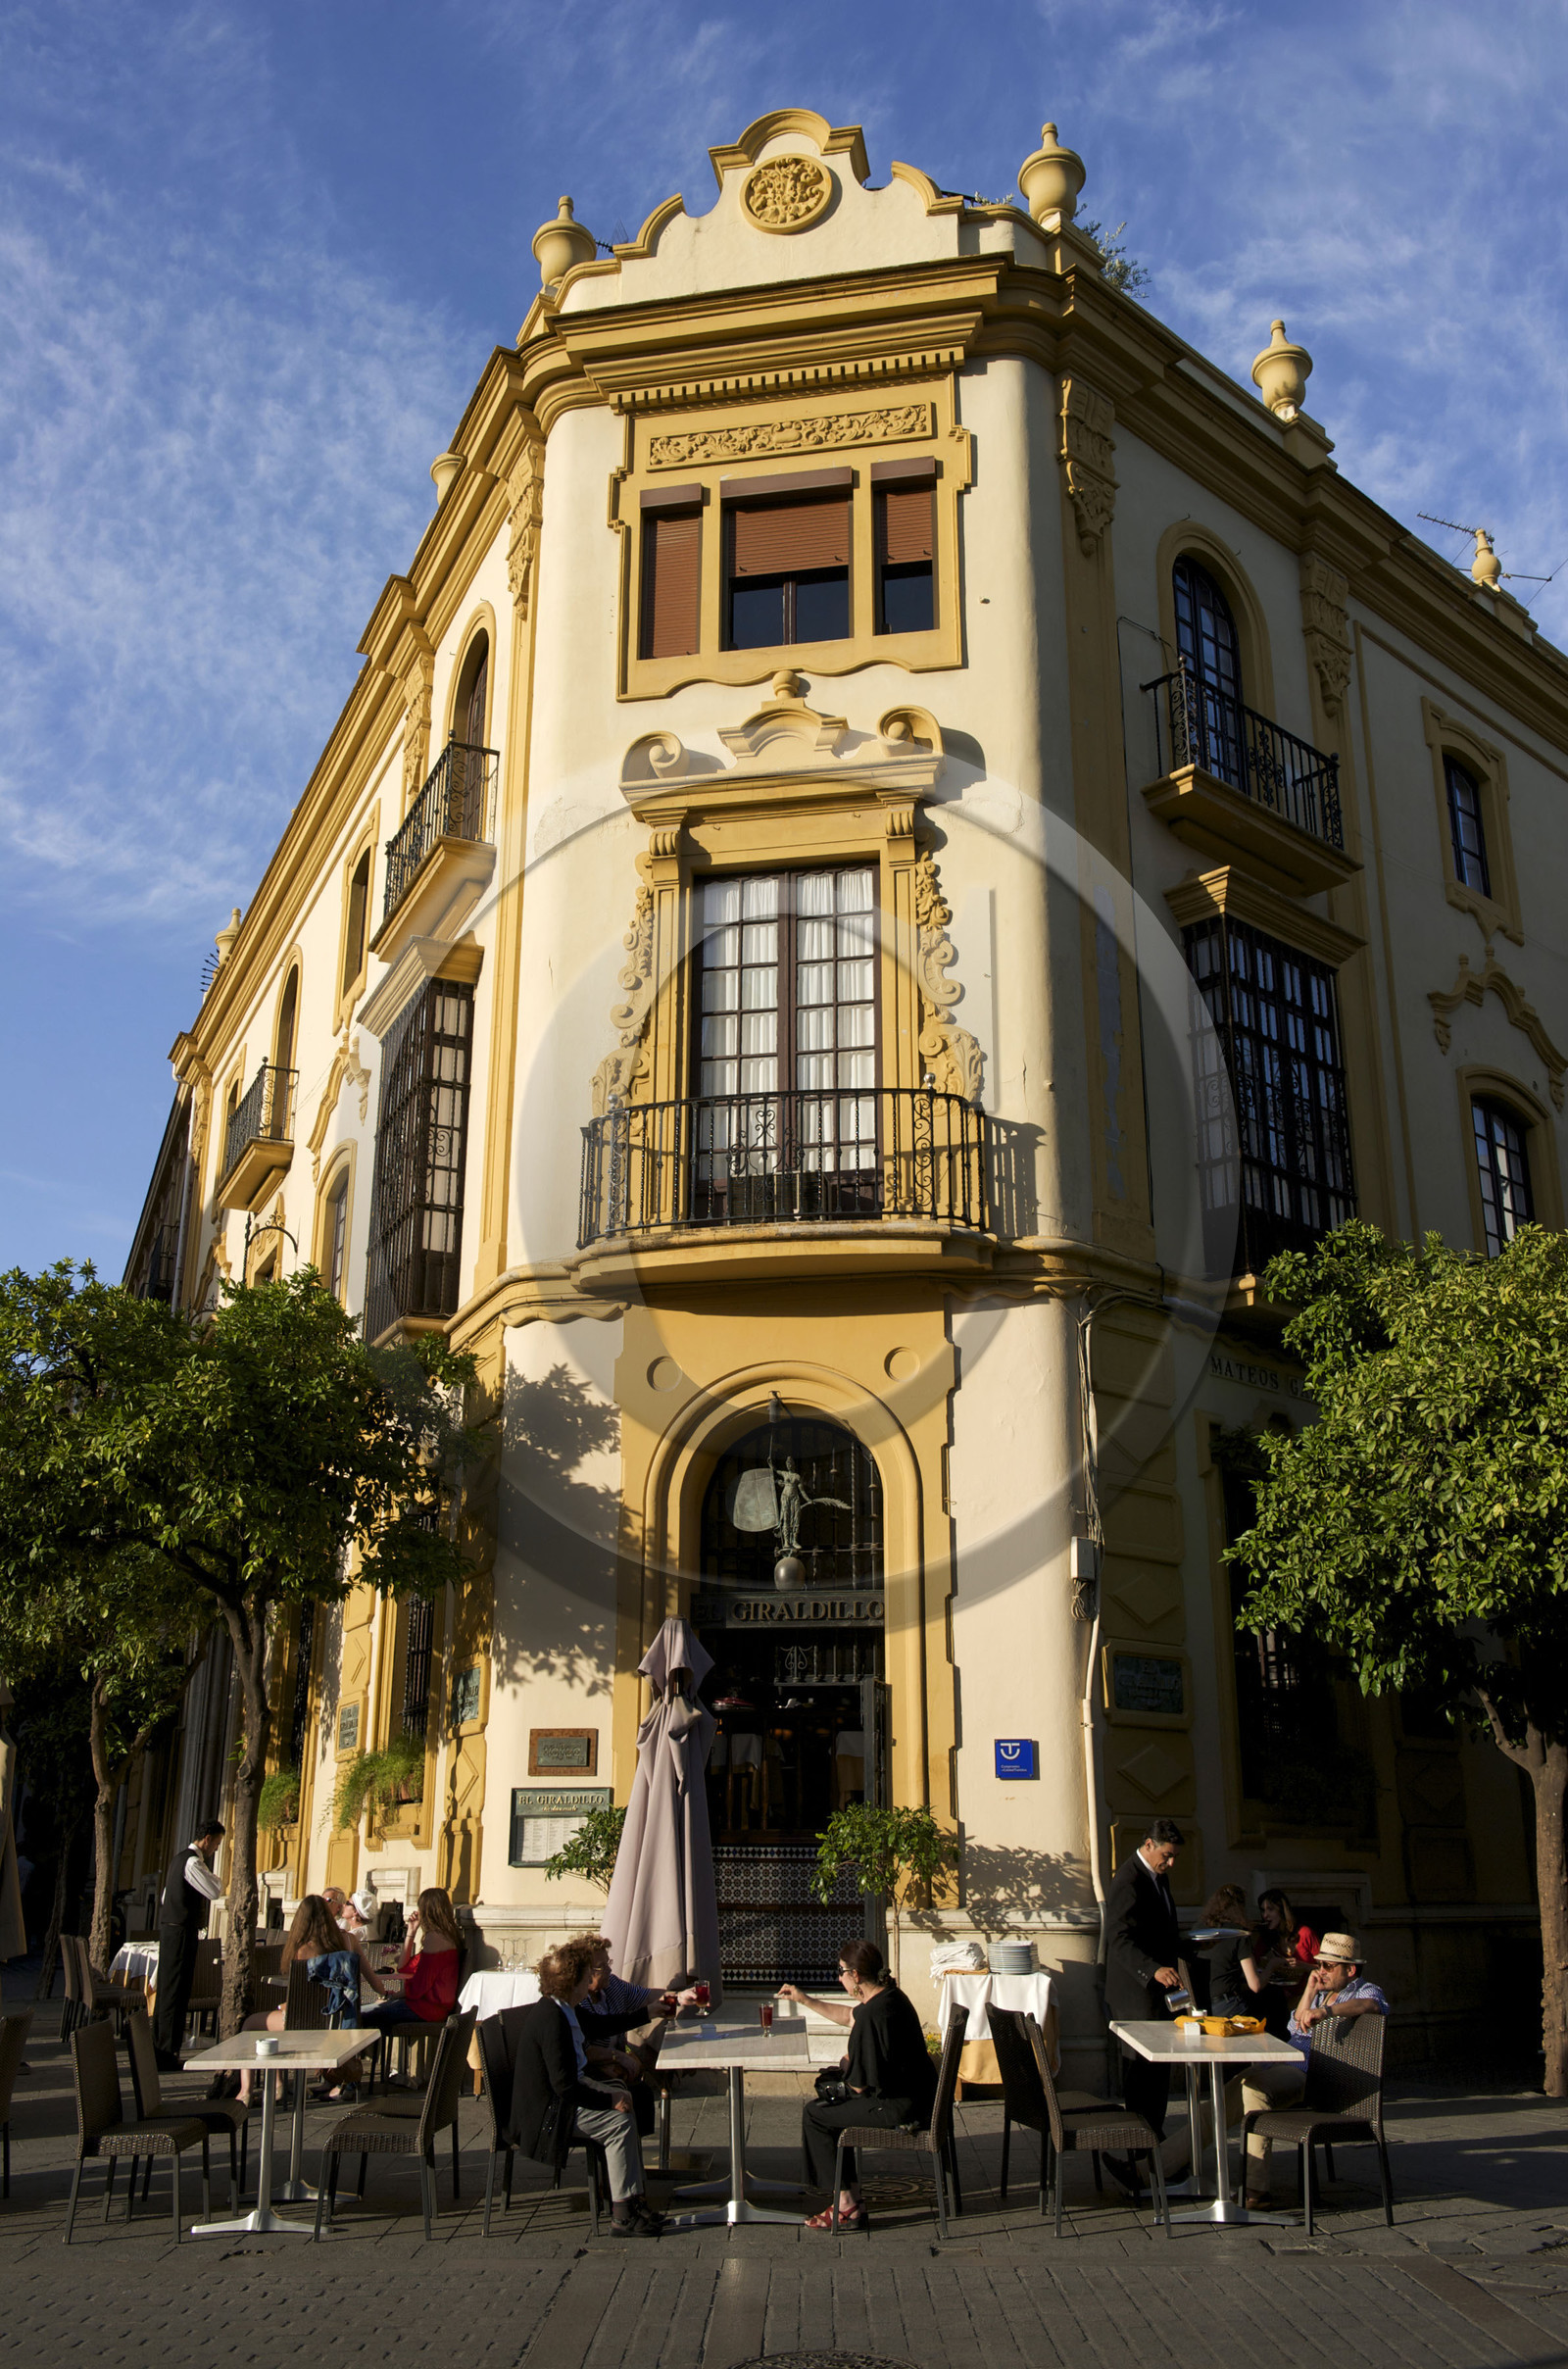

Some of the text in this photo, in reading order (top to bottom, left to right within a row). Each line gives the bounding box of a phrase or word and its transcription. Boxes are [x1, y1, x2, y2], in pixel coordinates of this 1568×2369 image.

[1211, 1357, 1279, 1390] MATEOS
[694, 1601, 885, 1622] EL GIRALDILLO
[518, 1795, 605, 1805] EL GIRALDILLO
